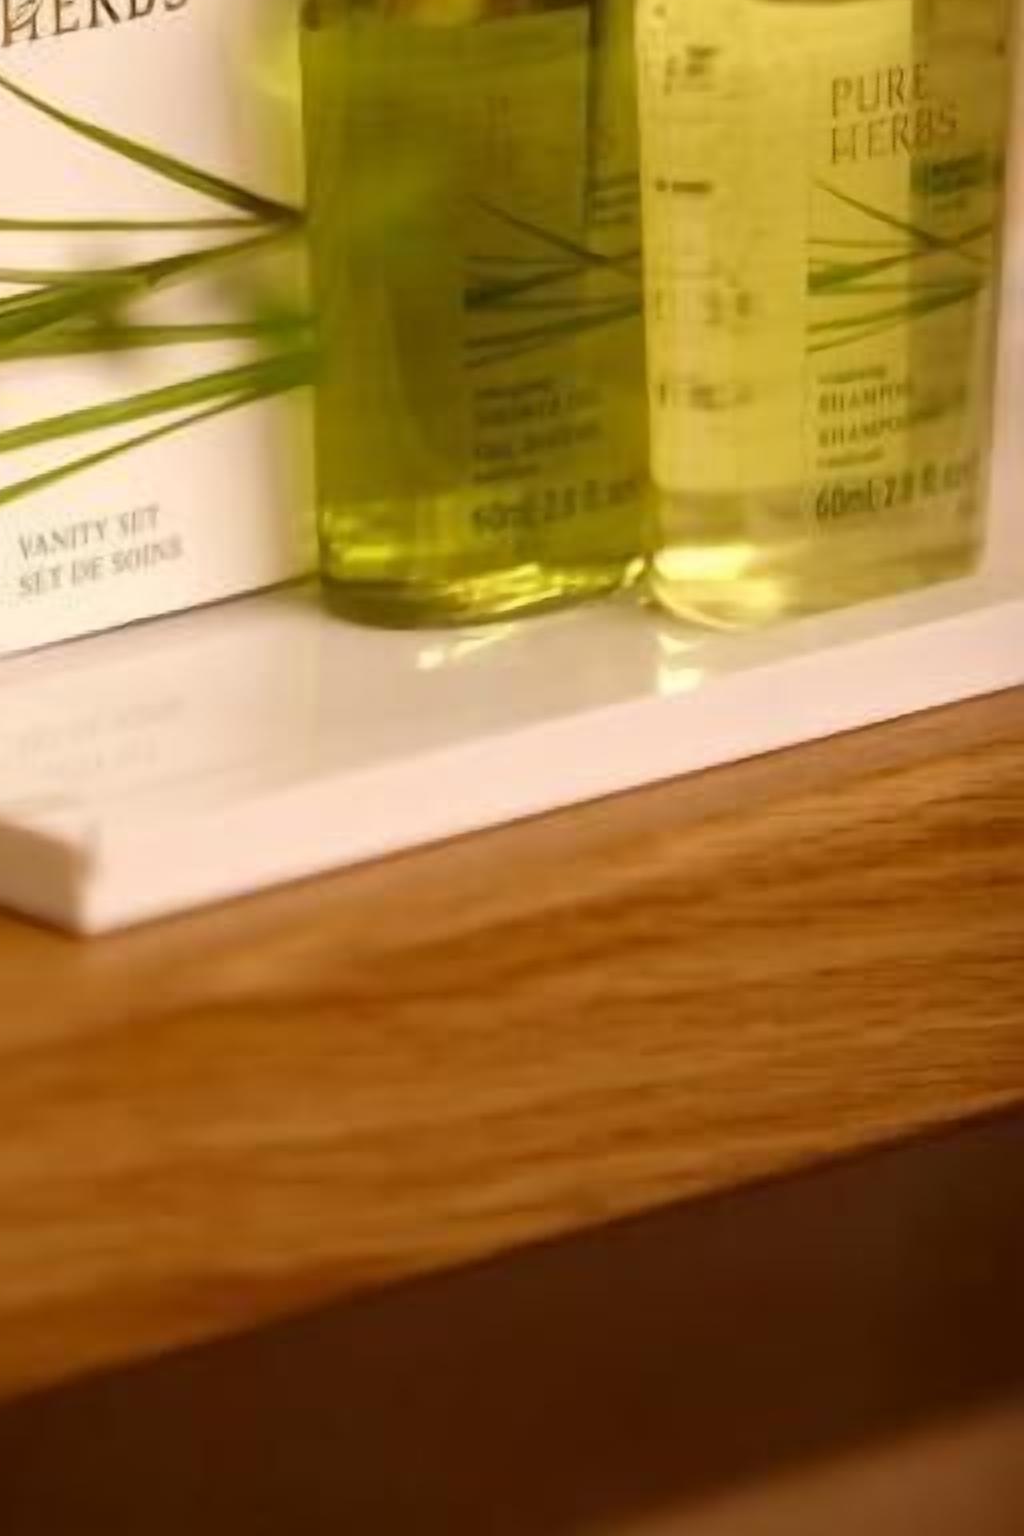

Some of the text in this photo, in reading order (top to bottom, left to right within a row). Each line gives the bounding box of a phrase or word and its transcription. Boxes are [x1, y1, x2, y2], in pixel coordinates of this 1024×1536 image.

[830, 62, 930, 119] PURE
[831, 94, 959, 166] HERBS
[17, 503, 160, 560] VANITY SET
[18, 532, 183, 597] SET DE SOINS
